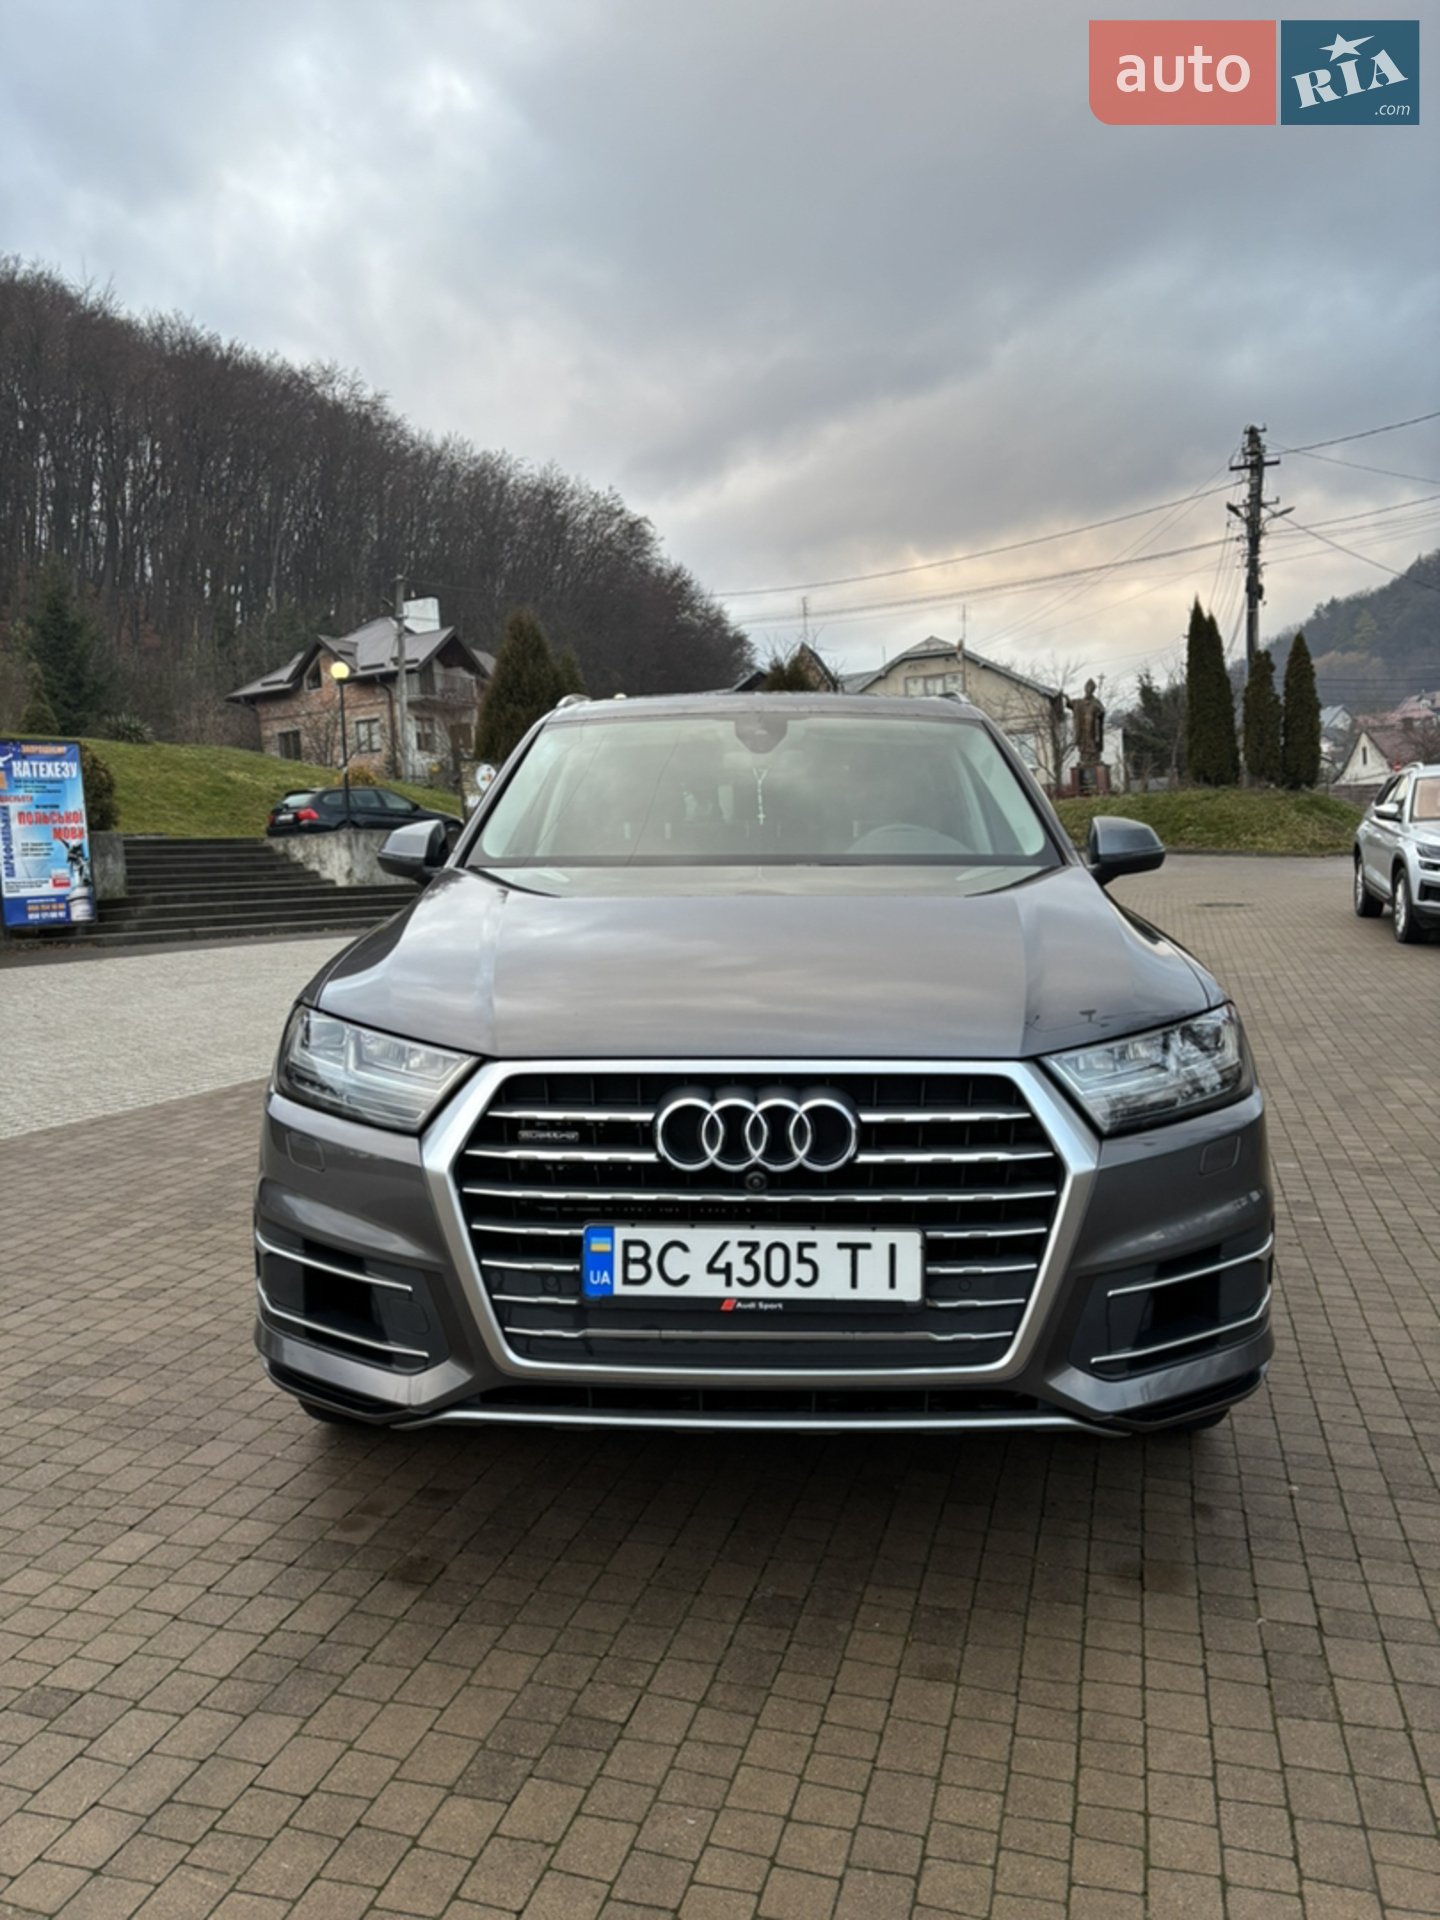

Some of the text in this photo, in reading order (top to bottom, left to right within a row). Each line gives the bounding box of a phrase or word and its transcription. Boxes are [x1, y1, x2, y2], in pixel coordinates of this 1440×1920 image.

[590, 1270, 611, 1285] UA
[622, 1239, 896, 1290] BC 4305 TI
